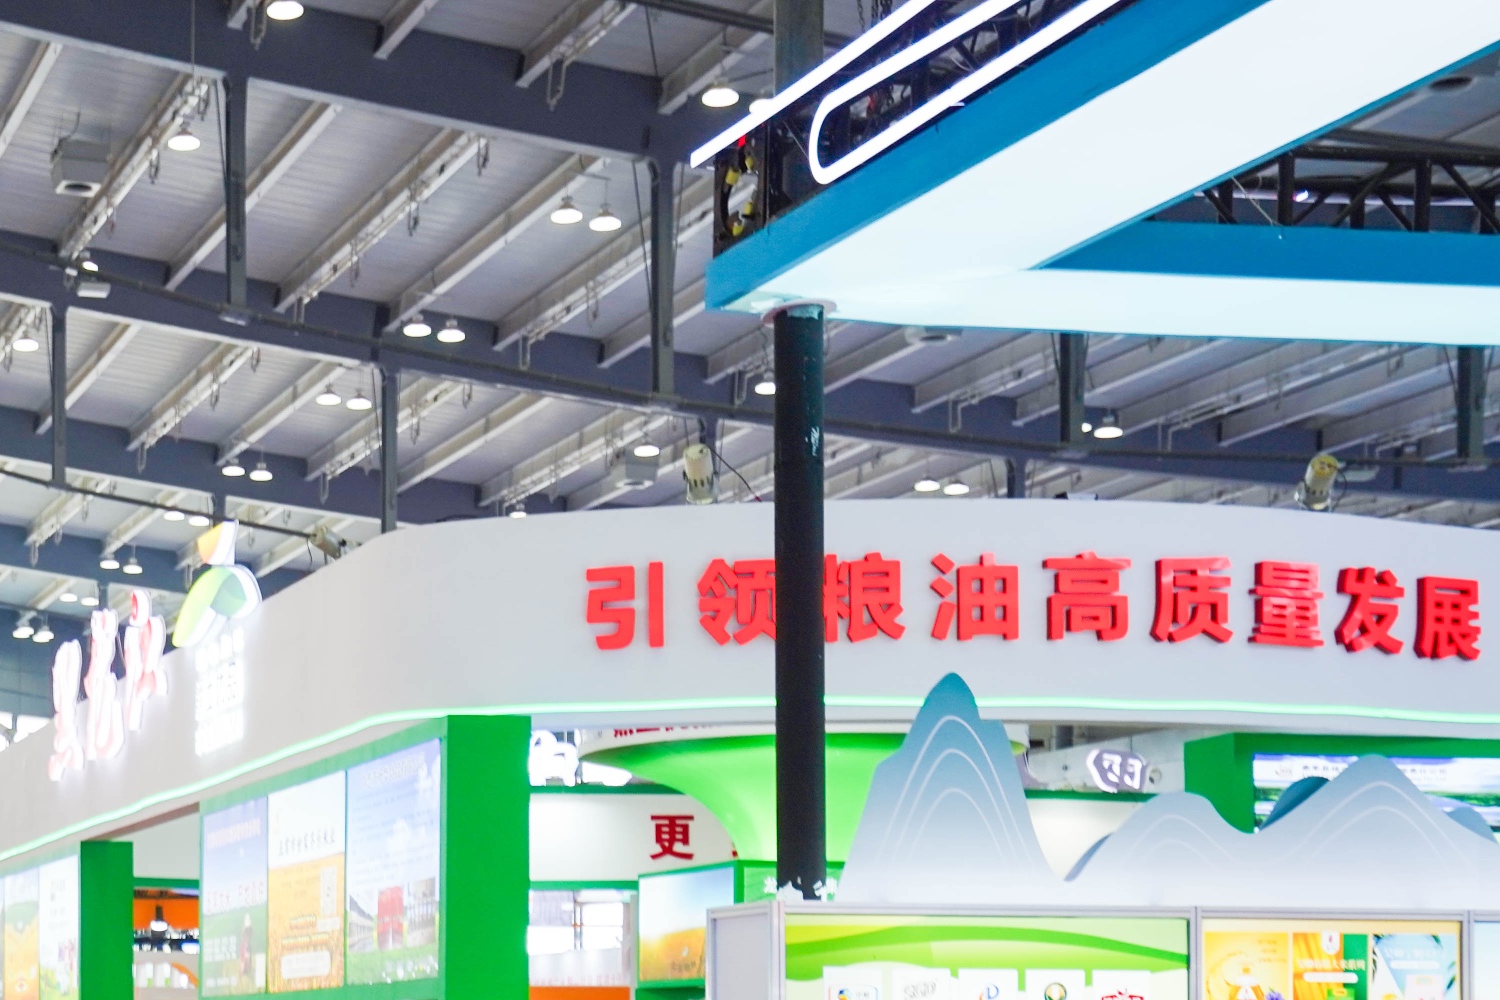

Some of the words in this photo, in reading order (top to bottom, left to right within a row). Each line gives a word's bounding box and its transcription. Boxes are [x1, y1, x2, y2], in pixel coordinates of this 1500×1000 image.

[585, 551, 1482, 660] 引领粮油高质量发展
[649, 814, 695, 861] 更
